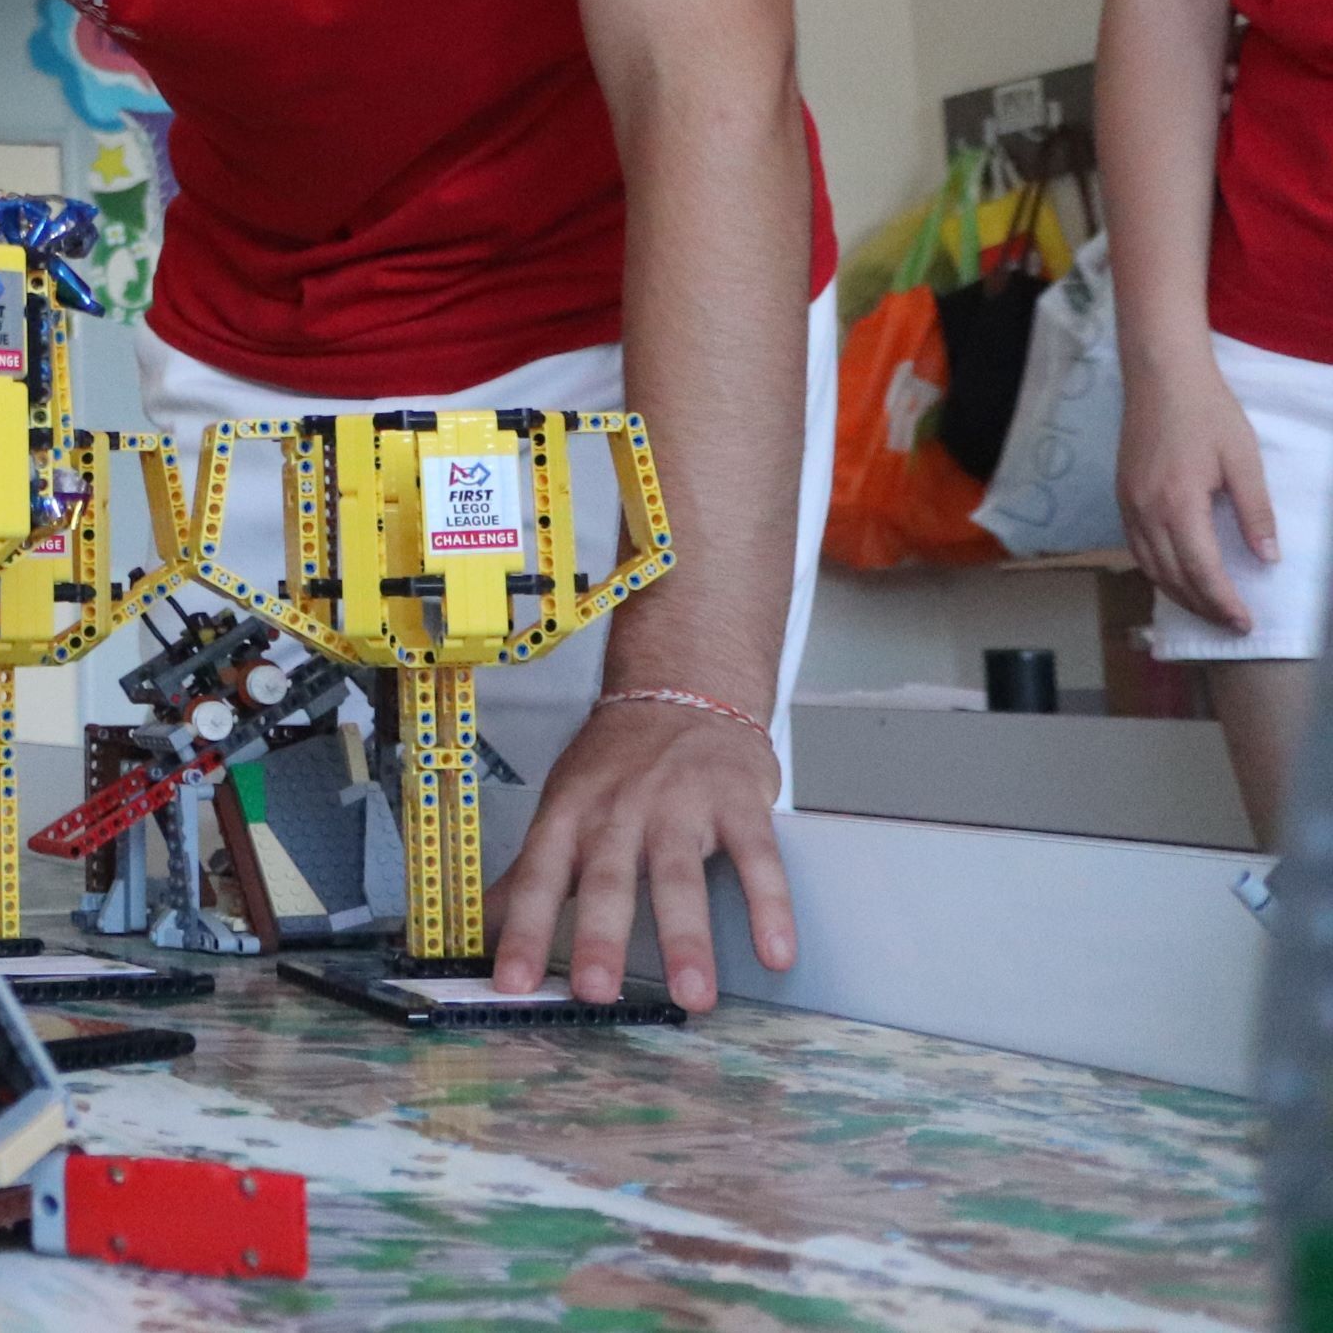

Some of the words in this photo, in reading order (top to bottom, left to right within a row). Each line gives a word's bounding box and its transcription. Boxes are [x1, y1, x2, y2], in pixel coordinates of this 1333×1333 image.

[449, 489, 494, 503] FIRST
[453, 503, 490, 515] LEGO
[445, 514, 500, 527] LEAGUE
[434, 532, 515, 547] CHALLENGE
